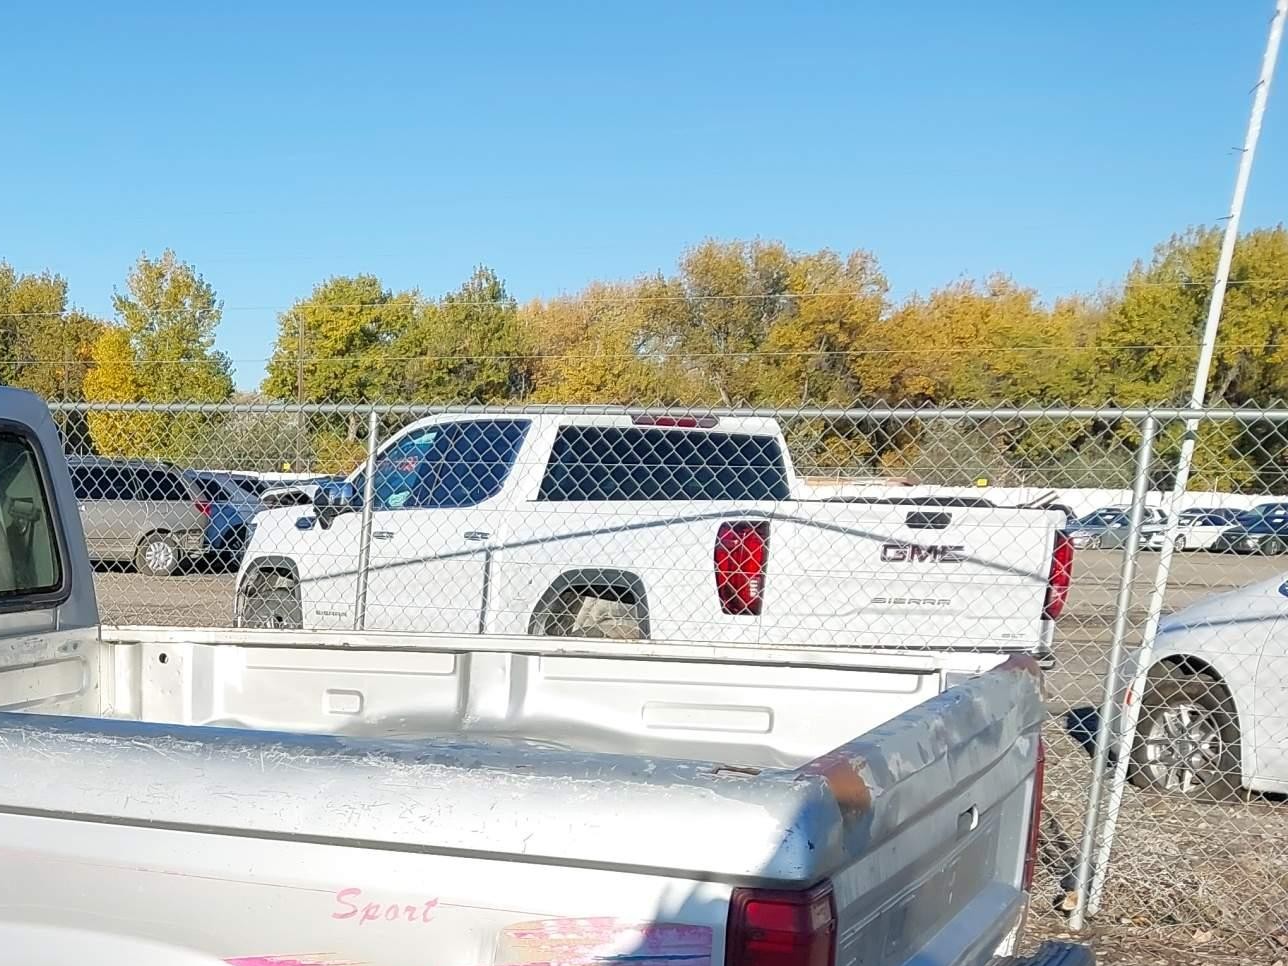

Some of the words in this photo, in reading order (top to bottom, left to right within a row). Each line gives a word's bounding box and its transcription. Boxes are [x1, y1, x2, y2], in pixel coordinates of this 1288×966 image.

[880, 543, 965, 564] GMC
[871, 597, 952, 607] SIERRA
[330, 887, 440, 926] Sport
